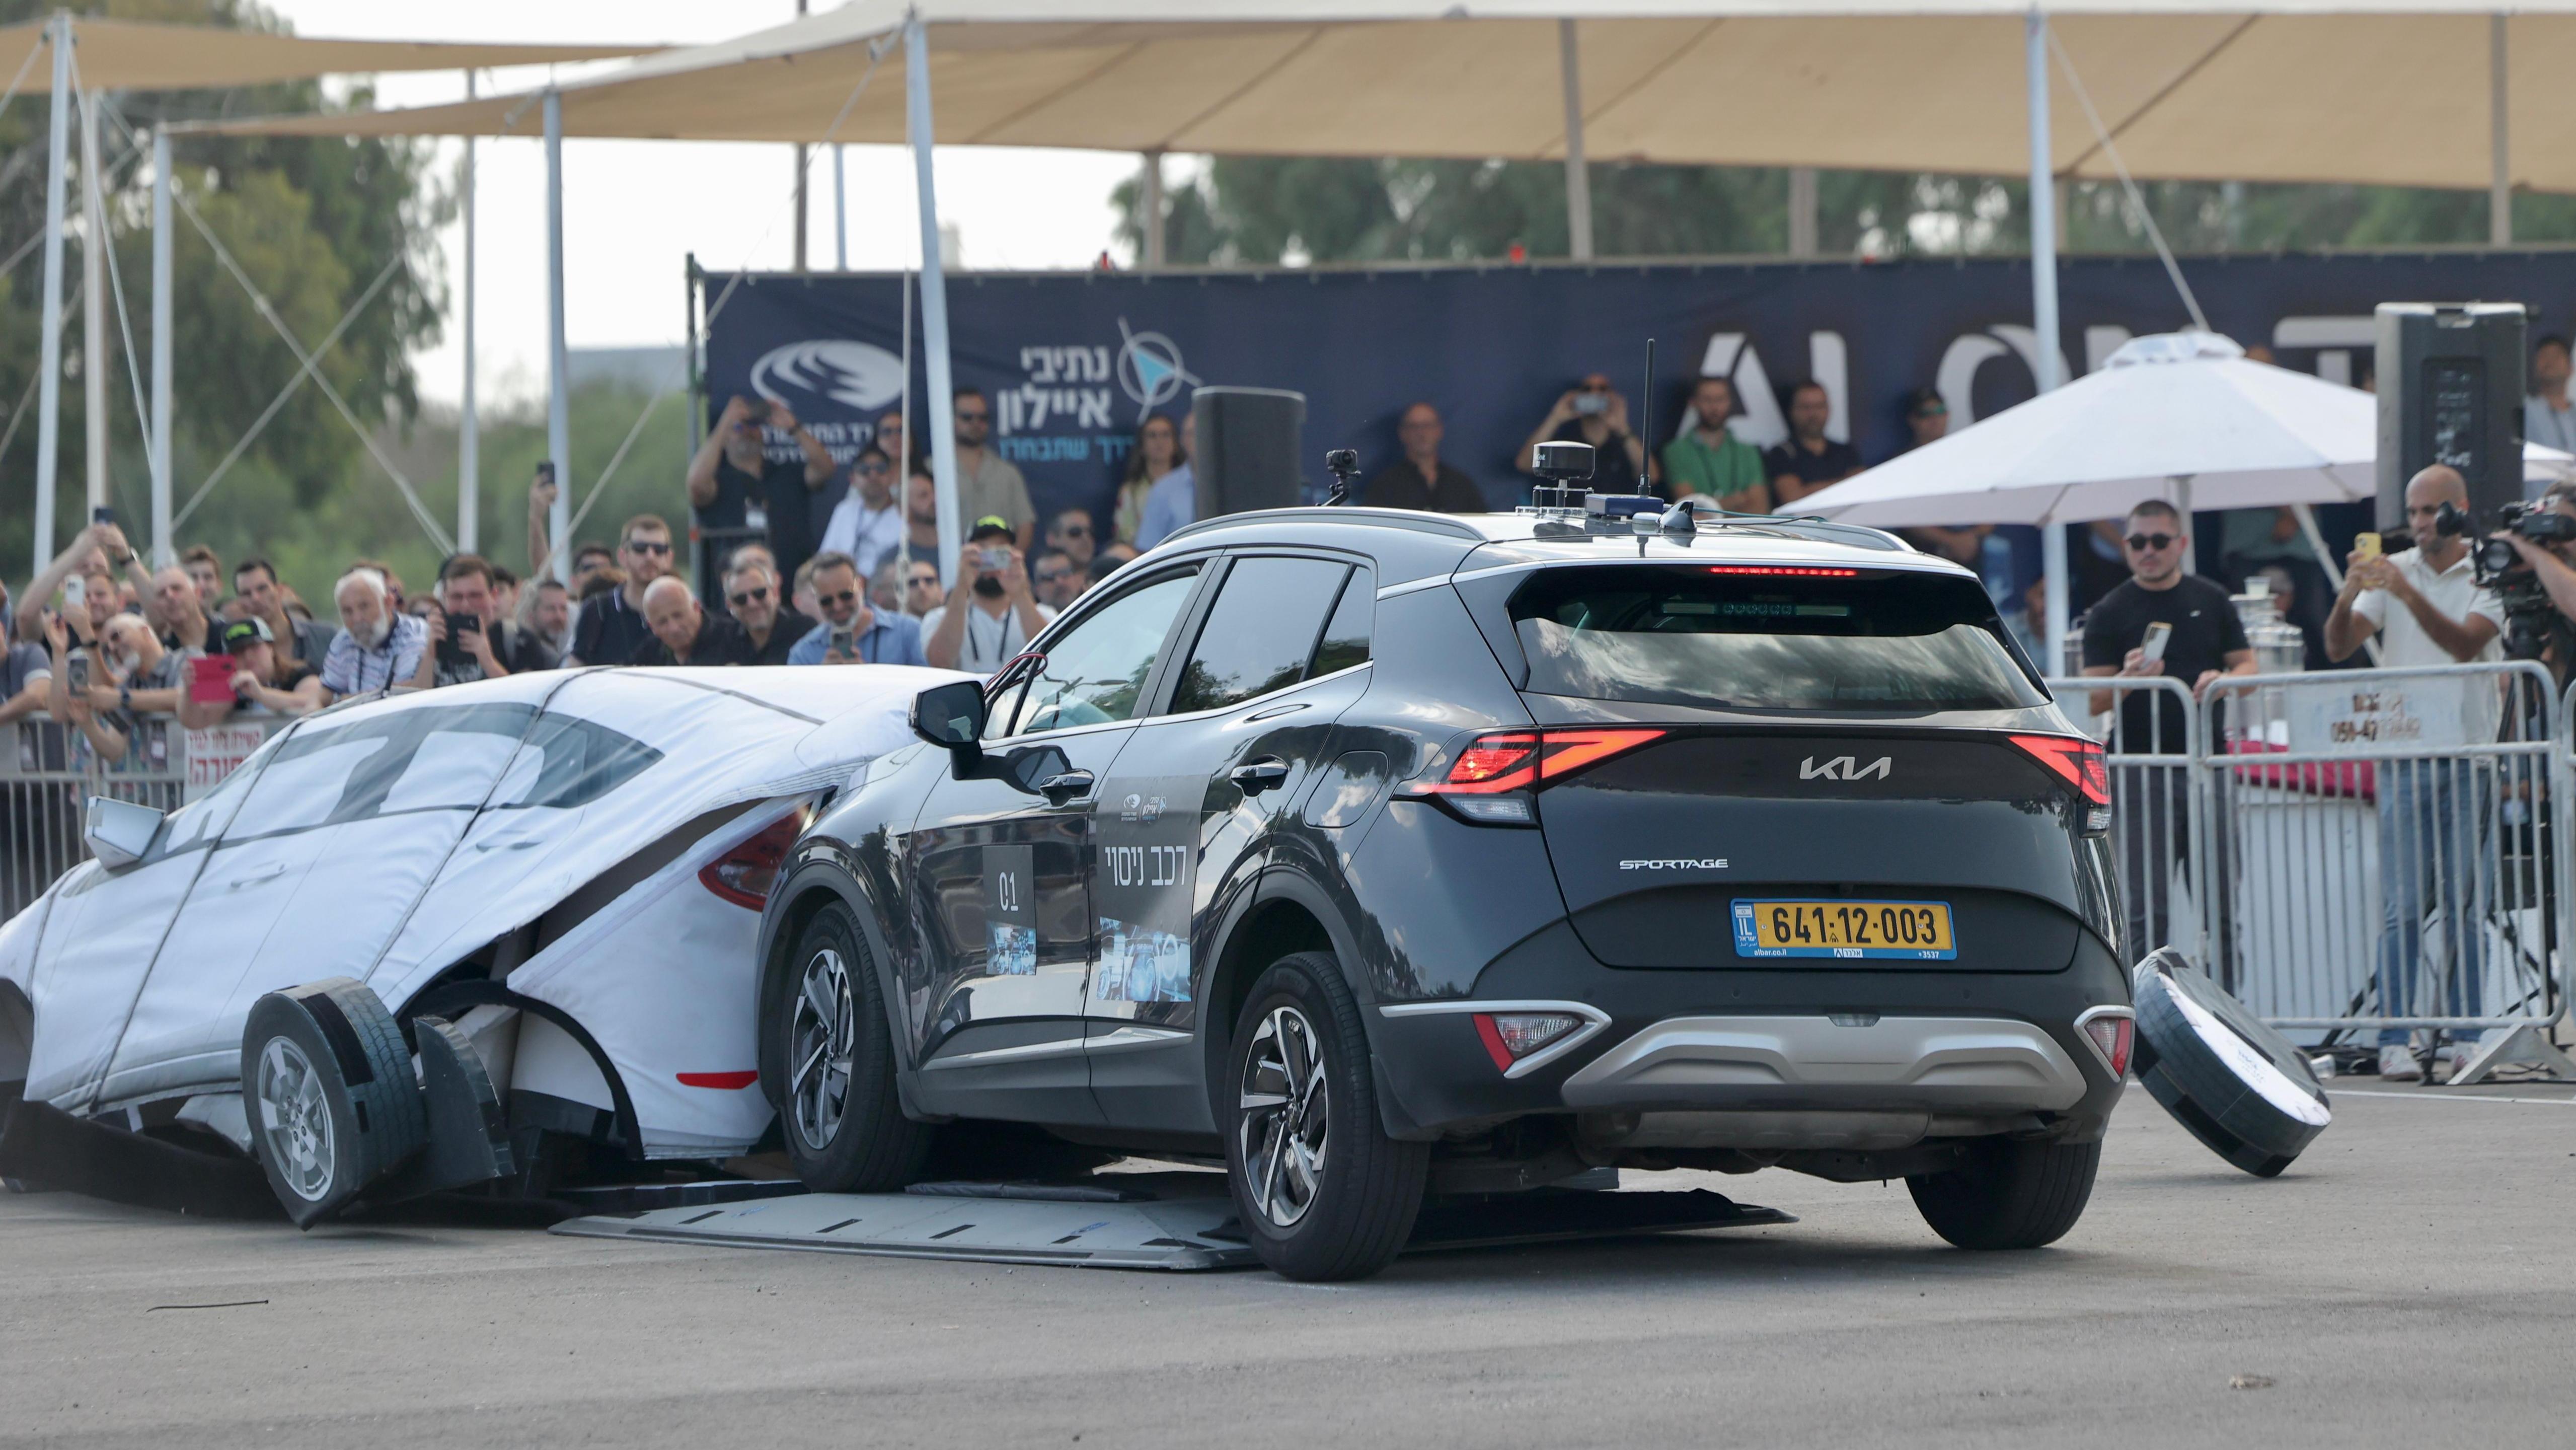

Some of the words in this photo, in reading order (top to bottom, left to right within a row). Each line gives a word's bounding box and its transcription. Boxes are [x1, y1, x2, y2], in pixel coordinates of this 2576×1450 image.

[1021, 345, 1109, 383] נתיבי
[997, 382, 1111, 436] איילון
[1799, 757, 1891, 780] KIA
[1105, 846, 1144, 886] ניסוי
[1151, 845, 1186, 886] רכב
[1619, 859, 1729, 871] SPORTAGE
[999, 872, 1019, 911] 01
[1738, 918, 1753, 935] IL
